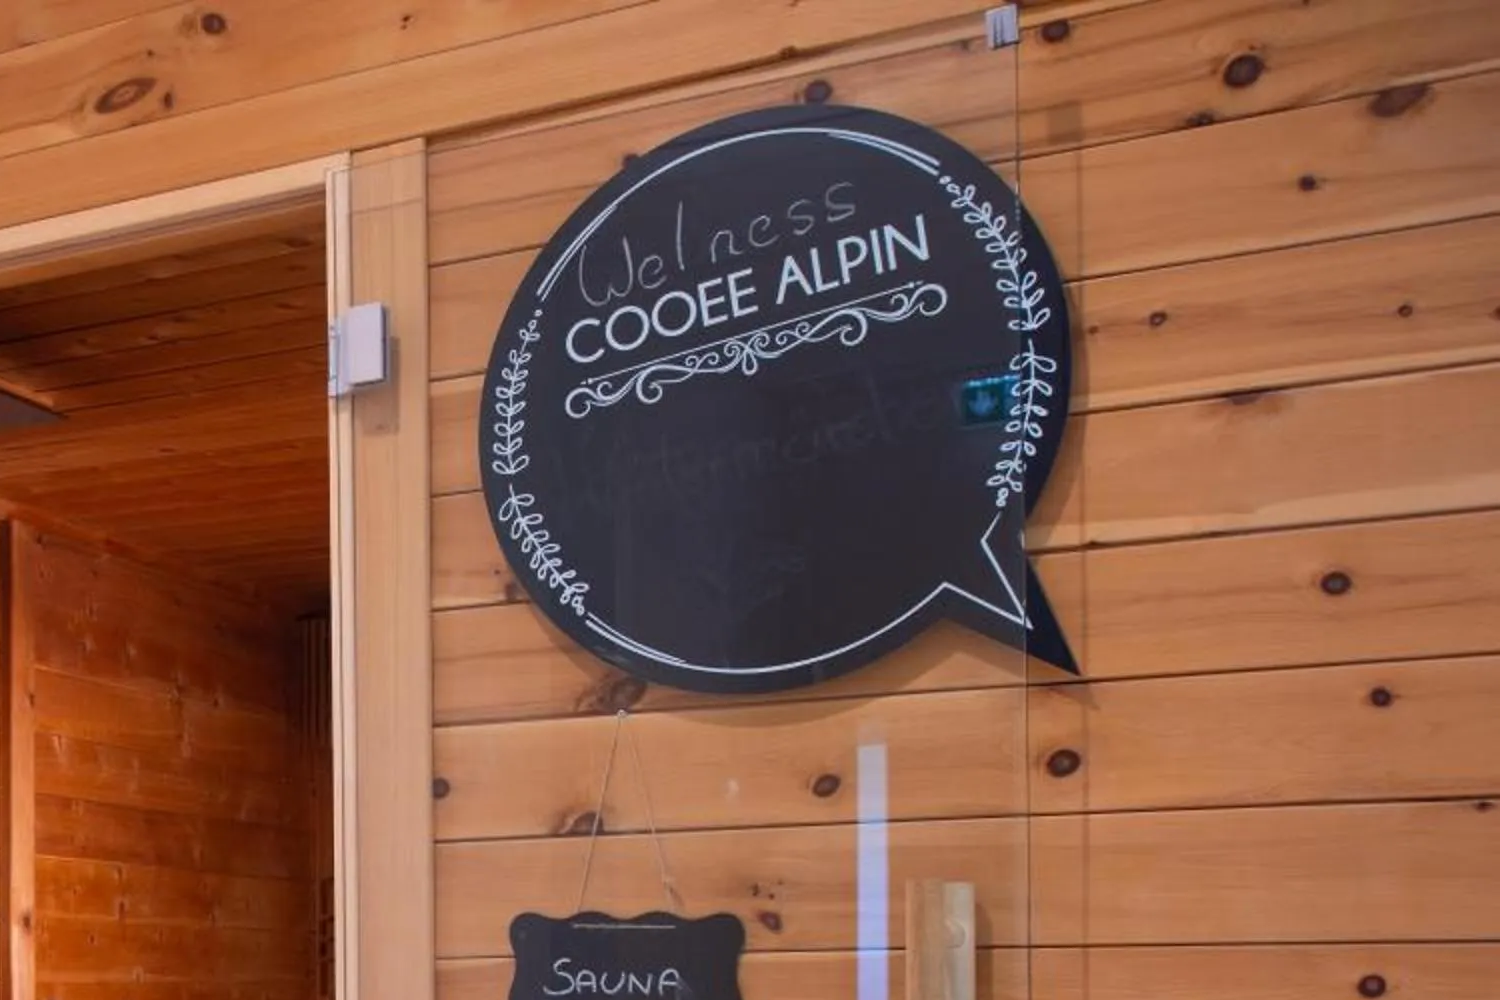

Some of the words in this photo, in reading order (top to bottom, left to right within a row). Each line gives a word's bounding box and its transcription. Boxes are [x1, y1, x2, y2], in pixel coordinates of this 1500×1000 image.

[564, 268, 759, 364] COOEE
[775, 213, 931, 305] ALPIN
[577, 180, 857, 307] Welness
[543, 957, 684, 998] SAUNA
